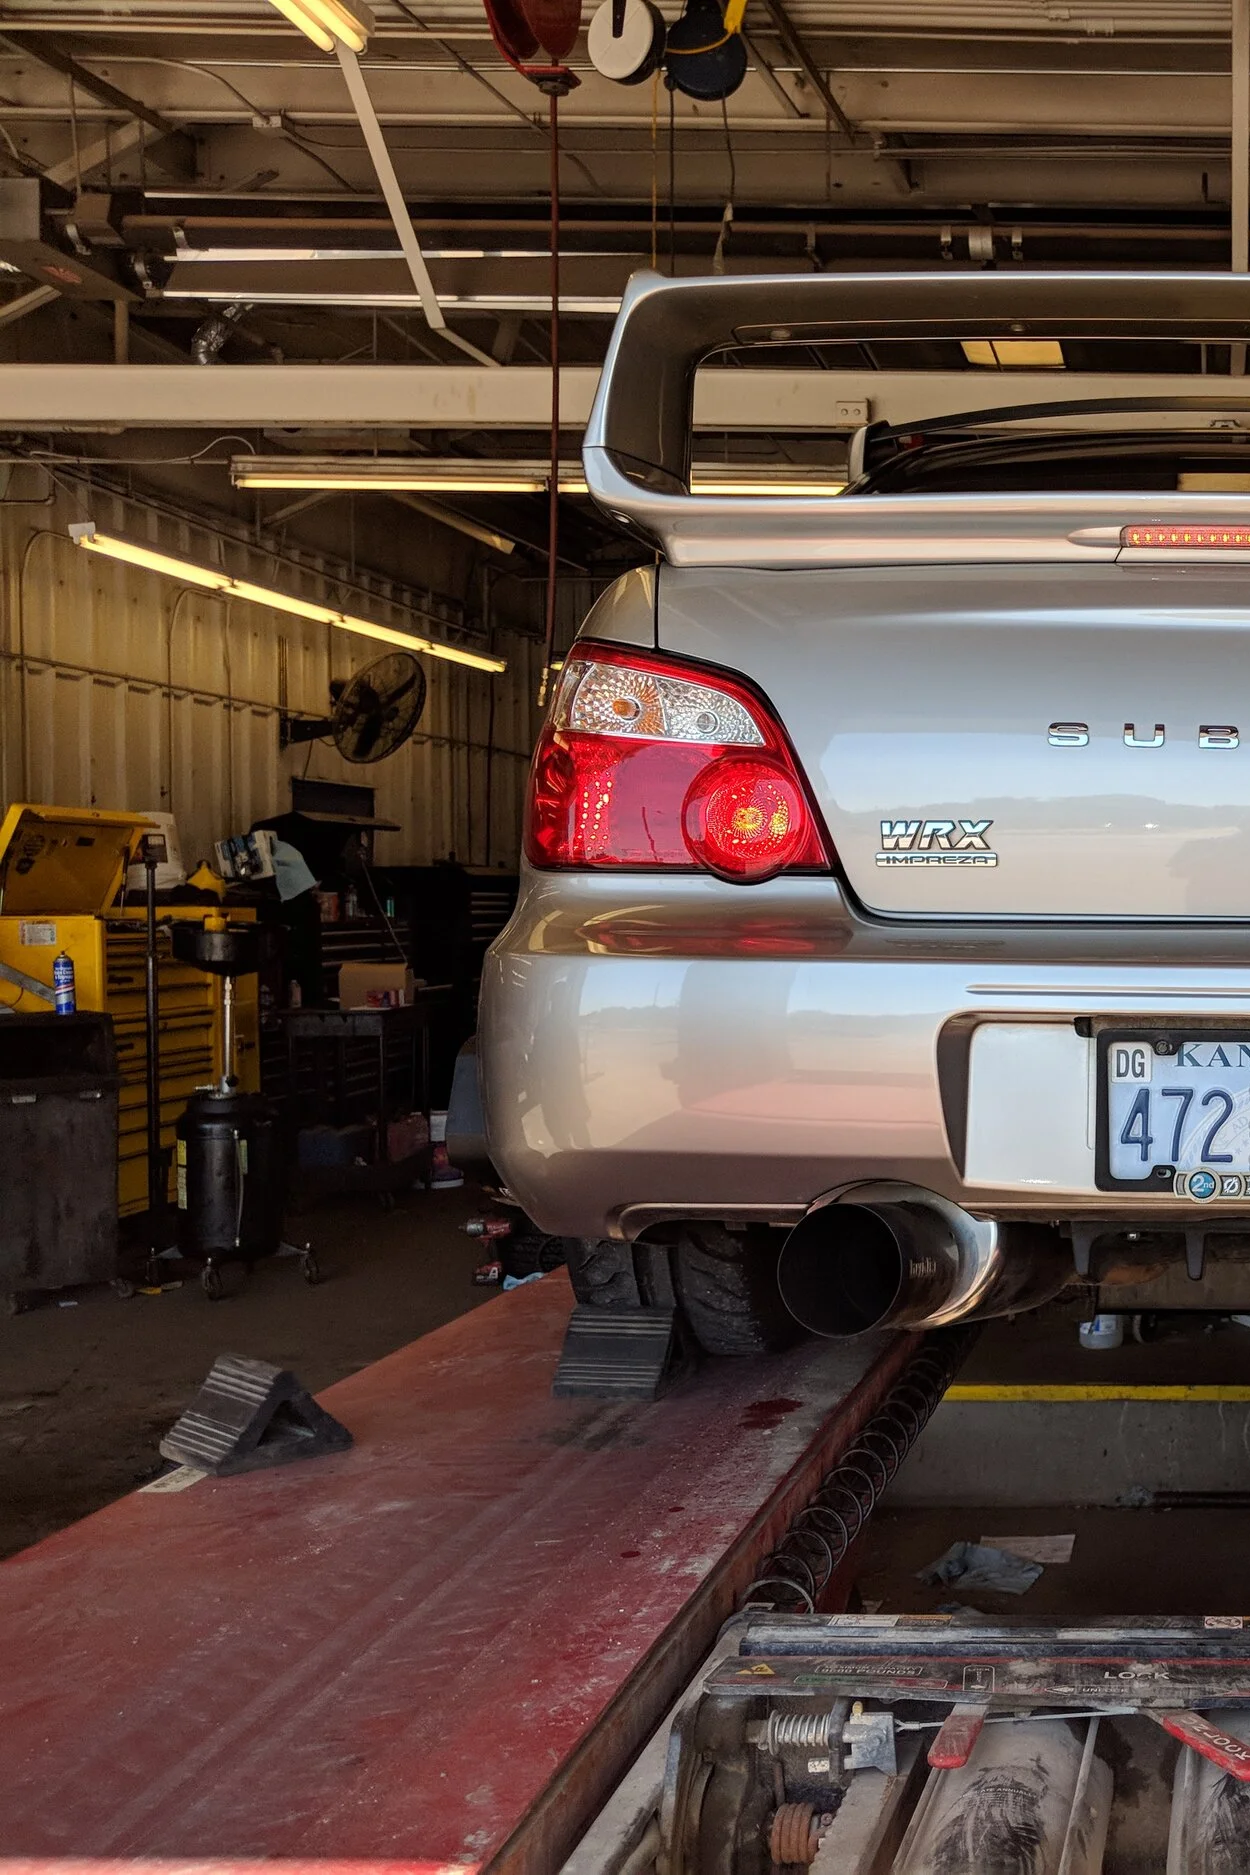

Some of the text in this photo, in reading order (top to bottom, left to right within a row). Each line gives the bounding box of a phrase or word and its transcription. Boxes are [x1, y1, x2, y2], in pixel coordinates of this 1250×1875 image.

[880, 820, 994, 850] WRX
[886, 855, 988, 865] IMPREZA
[1115, 1048, 1146, 1079] DG
[1120, 1088, 1234, 1163] 472
[1192, 1175, 1214, 1193] 2nd
